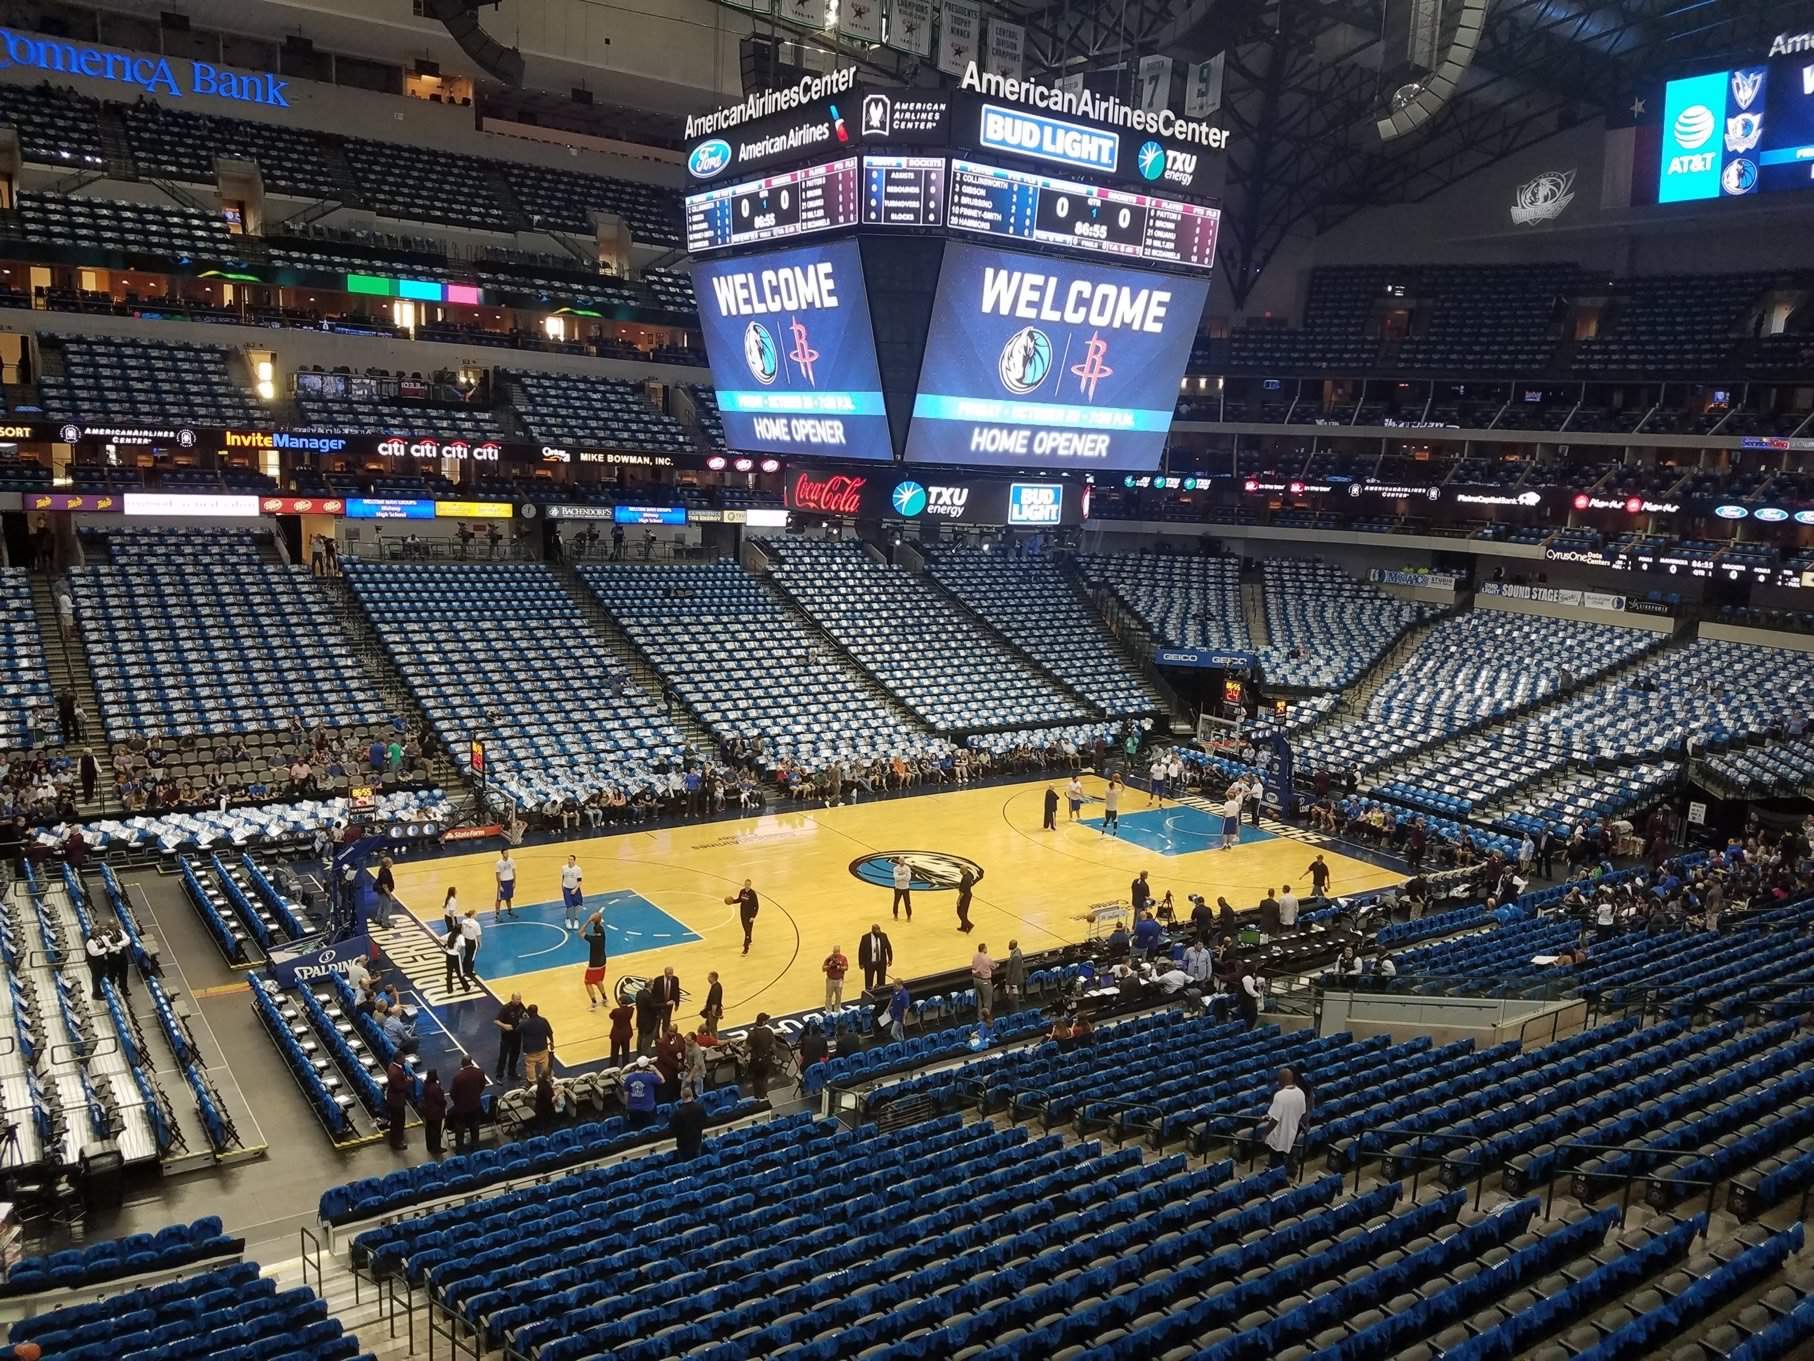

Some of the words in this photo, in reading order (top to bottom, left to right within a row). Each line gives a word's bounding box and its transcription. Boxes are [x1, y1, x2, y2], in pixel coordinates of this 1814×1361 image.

[191, 61, 290, 108] Bank
[1147, 74, 1160, 108] 7
[684, 65, 857, 140] AmericanAirlinesCenter
[893, 101, 947, 111] AMERICAN
[961, 61, 1230, 148] AmericanAirlinesCenter
[893, 111, 940, 121] AIRLINES
[738, 134, 787, 162] American
[787, 122, 830, 149] Airlines
[986, 113, 1041, 148] BUD
[1042, 125, 1115, 164] LIGHT
[695, 145, 723, 171] Ford
[1166, 149, 1198, 173] TXU
[1667, 152, 1716, 175] AT&T
[1165, 170, 1193, 186] energy
[741, 198, 750, 218] 0
[780, 189, 789, 210] 0
[762, 200, 767, 209] 1
[884, 200, 920, 208] TURNOVERS
[1056, 196, 1069, 218] 0
[1118, 208, 1131, 228] 0
[1091, 208, 1097, 218] 1
[712, 261, 839, 317] WELCOME
[980, 265, 1172, 334] WELCOME
[753, 416, 791, 441] HOME
[791, 418, 846, 445] OPENER
[226, 431, 347, 453] InviteManager
[378, 440, 405, 457] citi
[410, 441, 437, 459] citi
[442, 443, 468, 460] citi
[473, 445, 499, 461] citi
[970, 427, 1031, 454] HOME
[1033, 432, 1110, 458] OPENER
[580, 452, 605, 463] MIKE
[607, 454, 653, 466] BOWMAN,
[655, 456, 674, 467] INC.
[795, 472, 867, 513] Coca-Cola
[927, 486, 969, 506] TXU
[1020, 488, 1054, 505] BUD
[927, 504, 965, 518] energy
[1012, 503, 1060, 521] LIGHT
[1546, 549, 1588, 563] CyrusOne
[1587, 557, 1611, 566] Centers
[1588, 551, 1603, 559] Data
[1502, 583, 1531, 600] SOUND
[1531, 586, 1559, 603] STAGE
[1163, 653, 1198, 662] GEICO
[1226, 688, 1239, 701] 24
